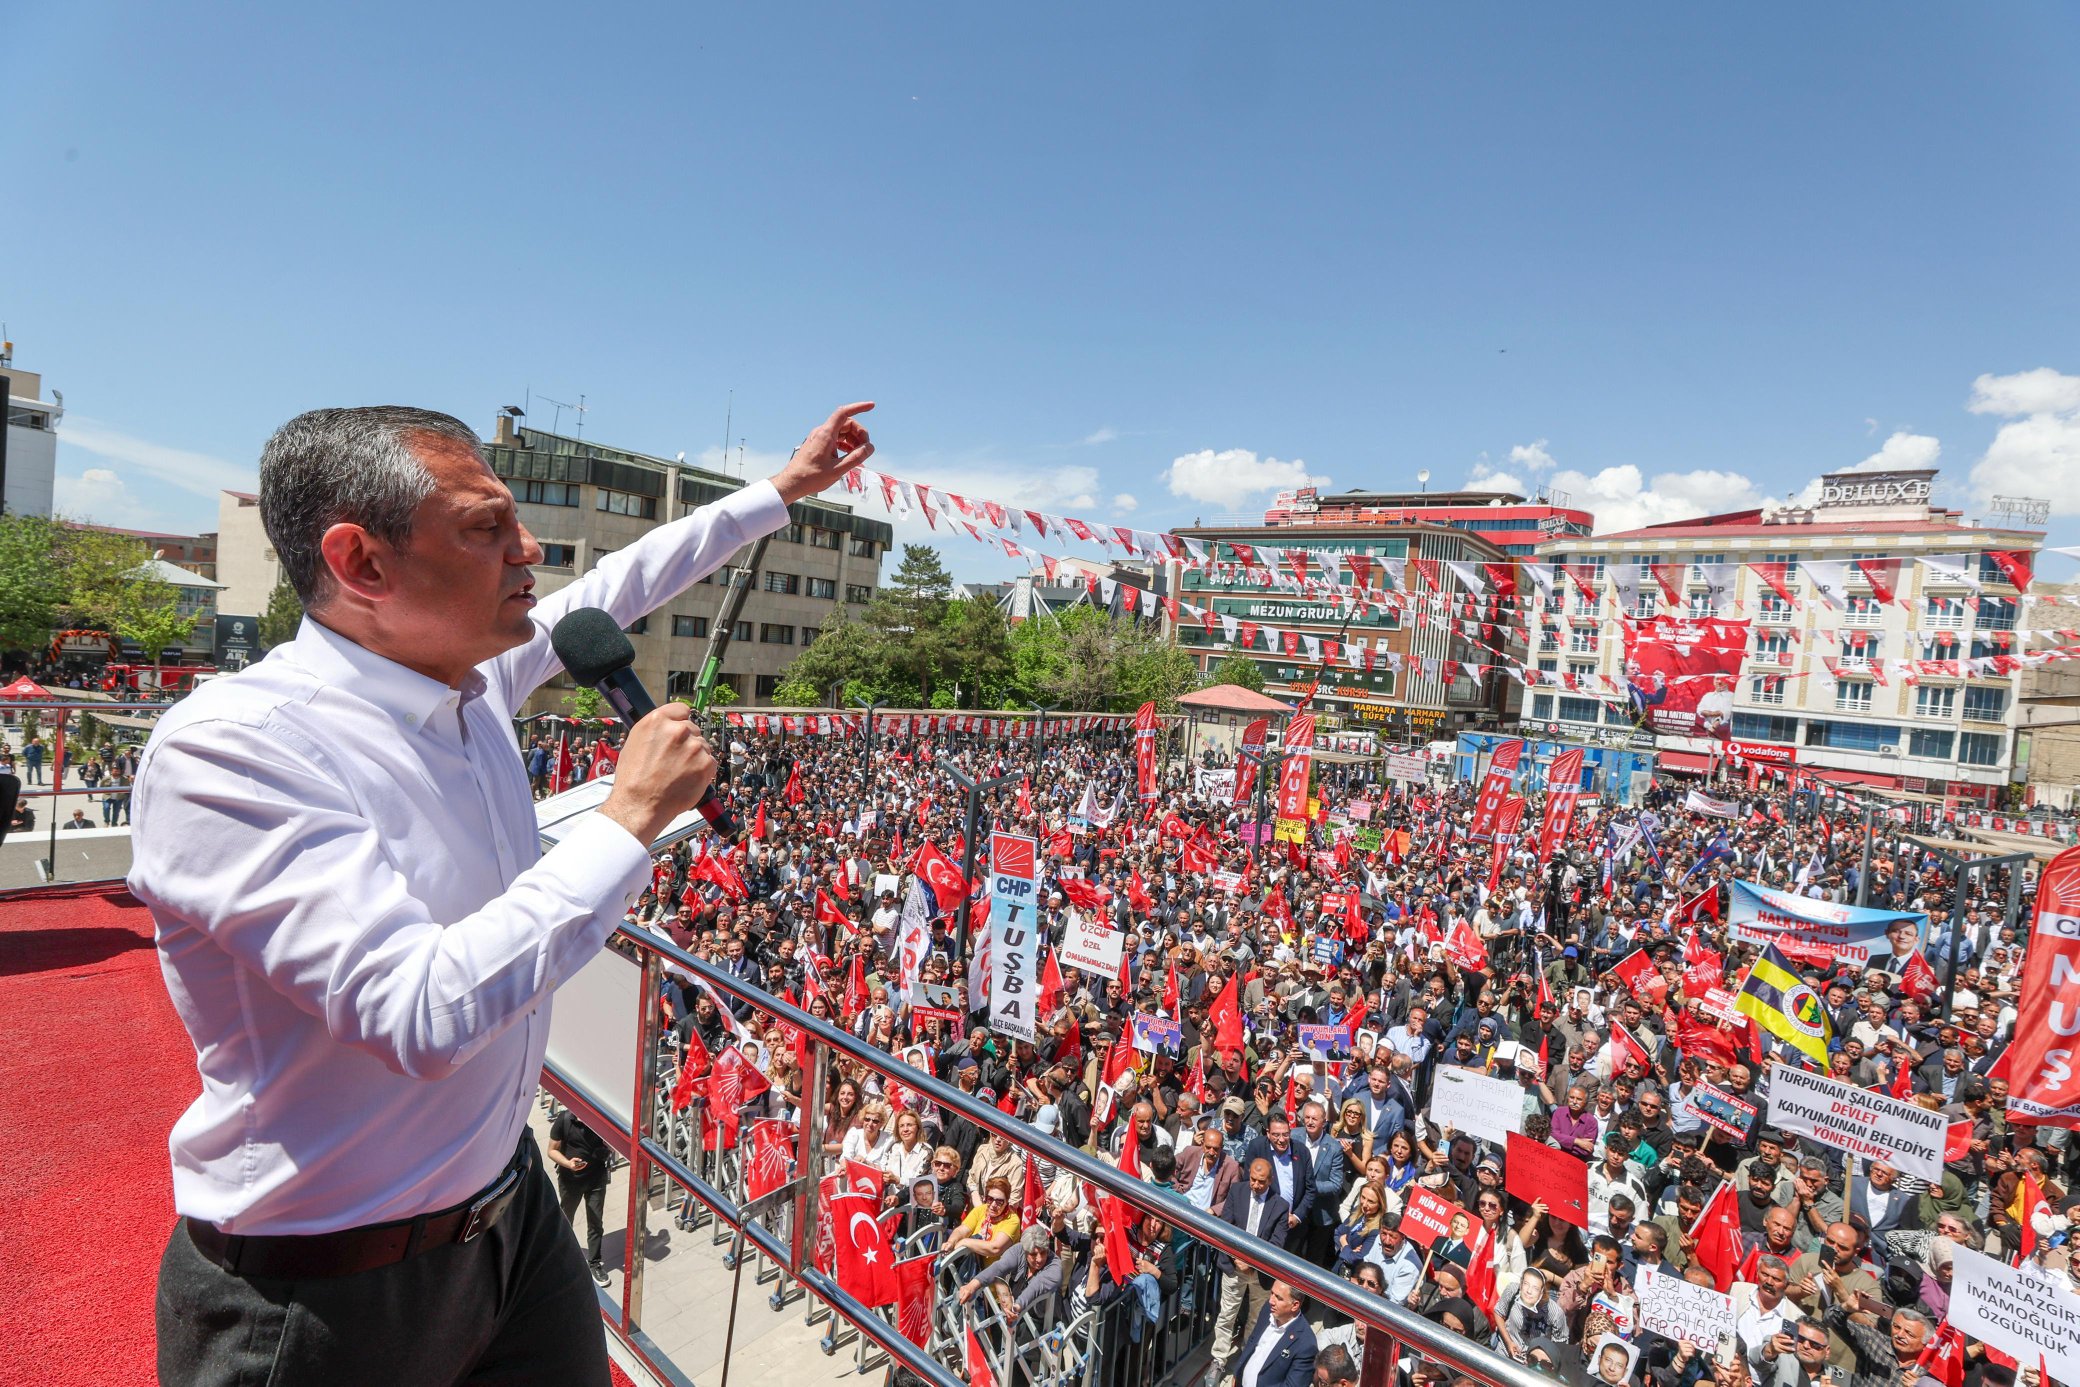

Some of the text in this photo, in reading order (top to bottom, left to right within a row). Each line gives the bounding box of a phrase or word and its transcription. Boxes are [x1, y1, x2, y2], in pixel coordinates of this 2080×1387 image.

[1823, 479, 1931, 503] DELUXE
[1250, 604, 1293, 619] MEZUN
[1317, 684, 1334, 695] SRC
[1337, 685, 1369, 698] KURSU
[1353, 703, 1396, 715] MARMARA
[1362, 711, 1386, 722] BÜFE
[1403, 708, 1446, 719] MARMARA
[1412, 715, 1435, 727] BÜFE
[1245, 744, 1261, 752] CHP
[1742, 746, 1789, 758] vodafone
[1494, 768, 1511, 776] CHP
[1287, 760, 1305, 814] MUŞ
[1555, 784, 1573, 792] CHP
[1482, 780, 1505, 830] MUŞ
[997, 877, 1031, 897] CHP
[1757, 910, 1791, 929] HALK
[1083, 938, 1101, 951] ÖZEL
[1000, 903, 1025, 1019] TUŞBA
[1300, 1025, 1348, 1035] KAYYUMLARA
[1313, 1032, 1335, 1041] SON!
[1729, 1099, 1755, 1115] SELAM
[1779, 1069, 1942, 1131] TURPUNAN ŞALGAMINAN
[2010, 1098, 2020, 1109] İL
[1831, 1101, 1878, 1125] DEVLET
[1723, 1125, 1745, 1139] DEVAM
[1777, 1099, 1936, 1162] KAYYUMUNAN BELEDİYE
[1813, 1125, 1894, 1161] YÖNETİLMEZ
[1418, 1195, 1447, 1216] HÛN BI
[1407, 1206, 1449, 1236] XÊR HATIN
[2016, 1273, 2055, 1299] 1071
[1648, 1287, 1734, 1326] SAYACAKLAR
[1691, 1286, 1719, 1308] YOK
[1642, 1312, 1669, 1336] VAR
[1667, 1307, 1706, 1334] DAHA
[1978, 1304, 2068, 1357] ÖZGÜRLÜK
